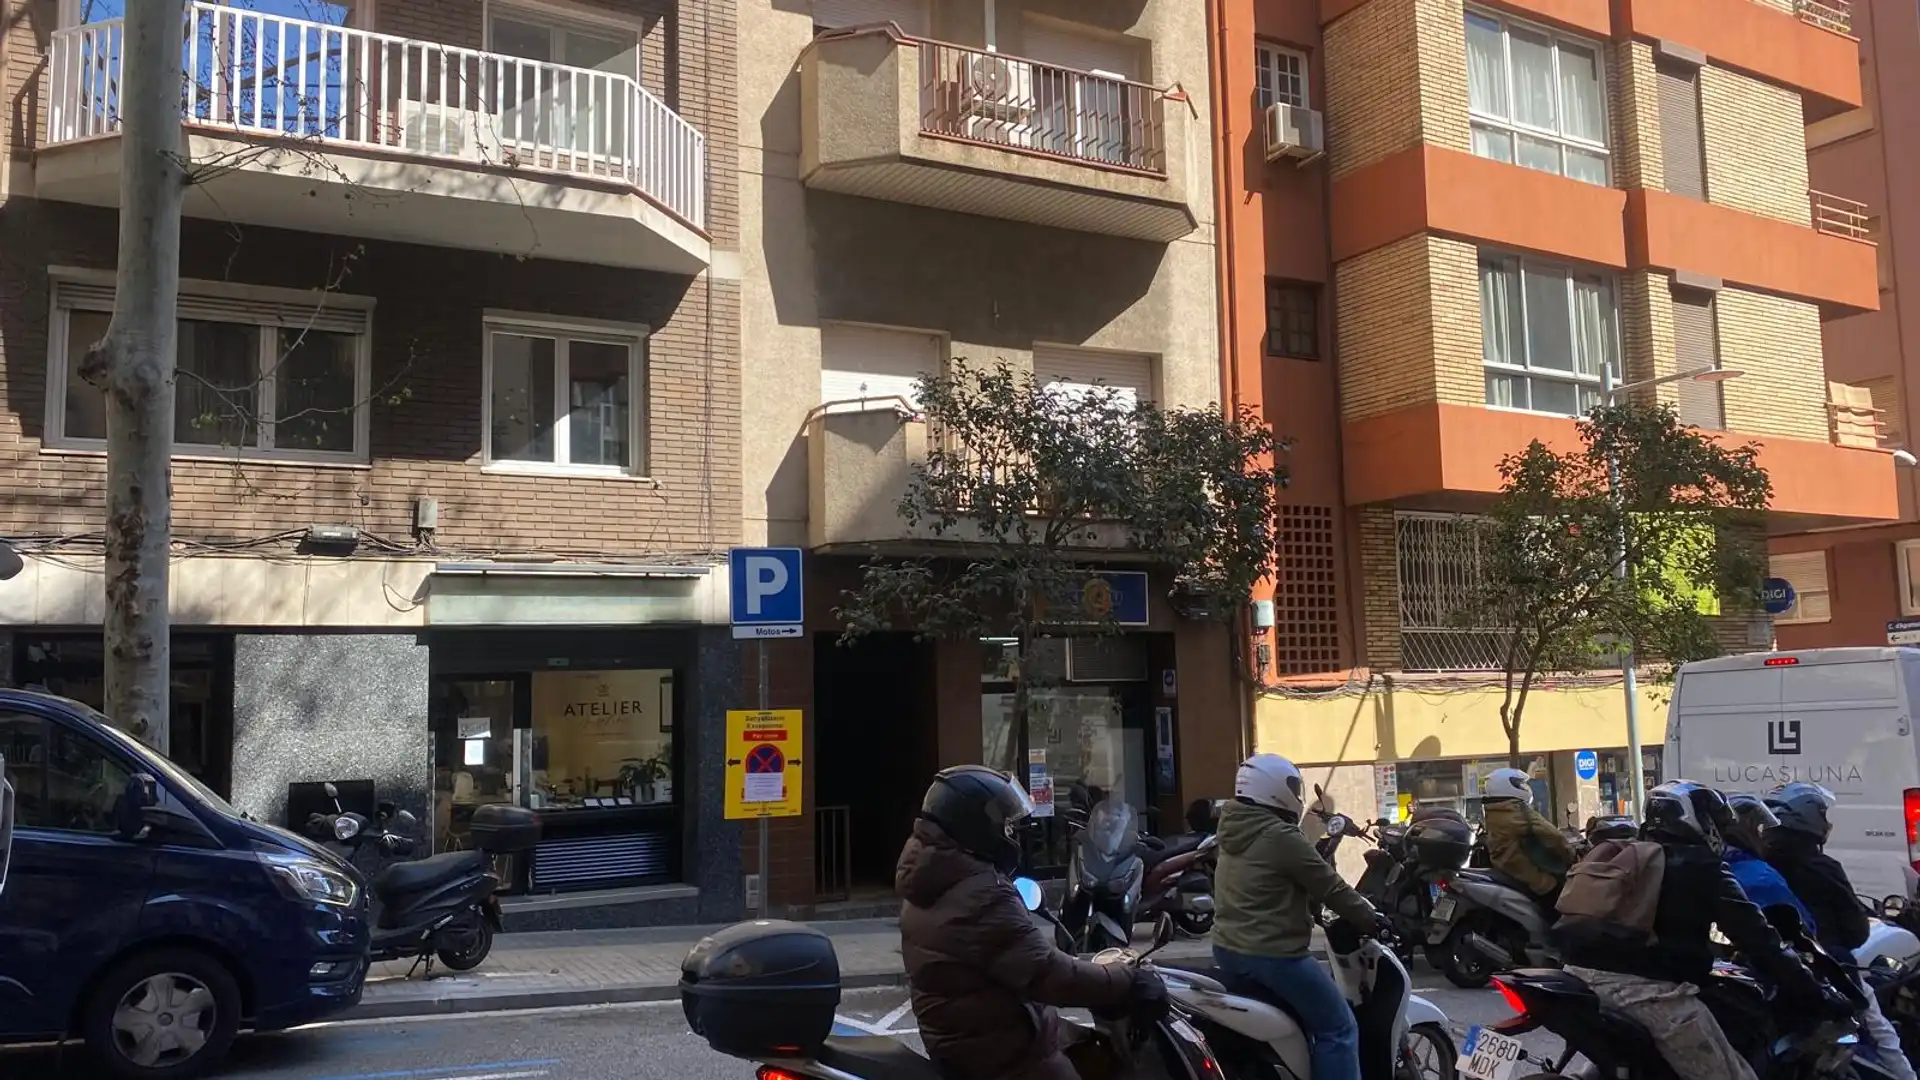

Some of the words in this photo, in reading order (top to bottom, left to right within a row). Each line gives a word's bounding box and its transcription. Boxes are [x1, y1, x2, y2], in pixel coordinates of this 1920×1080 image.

[745, 556, 789, 615] P
[1761, 588, 1786, 600] DIGI
[755, 627, 781, 637] Motos
[564, 700, 643, 718] ATELIER
[1579, 758, 1595, 768] DIGI
[1477, 1033, 1518, 1061] 2680
[1468, 1052, 1500, 1079] MDK
